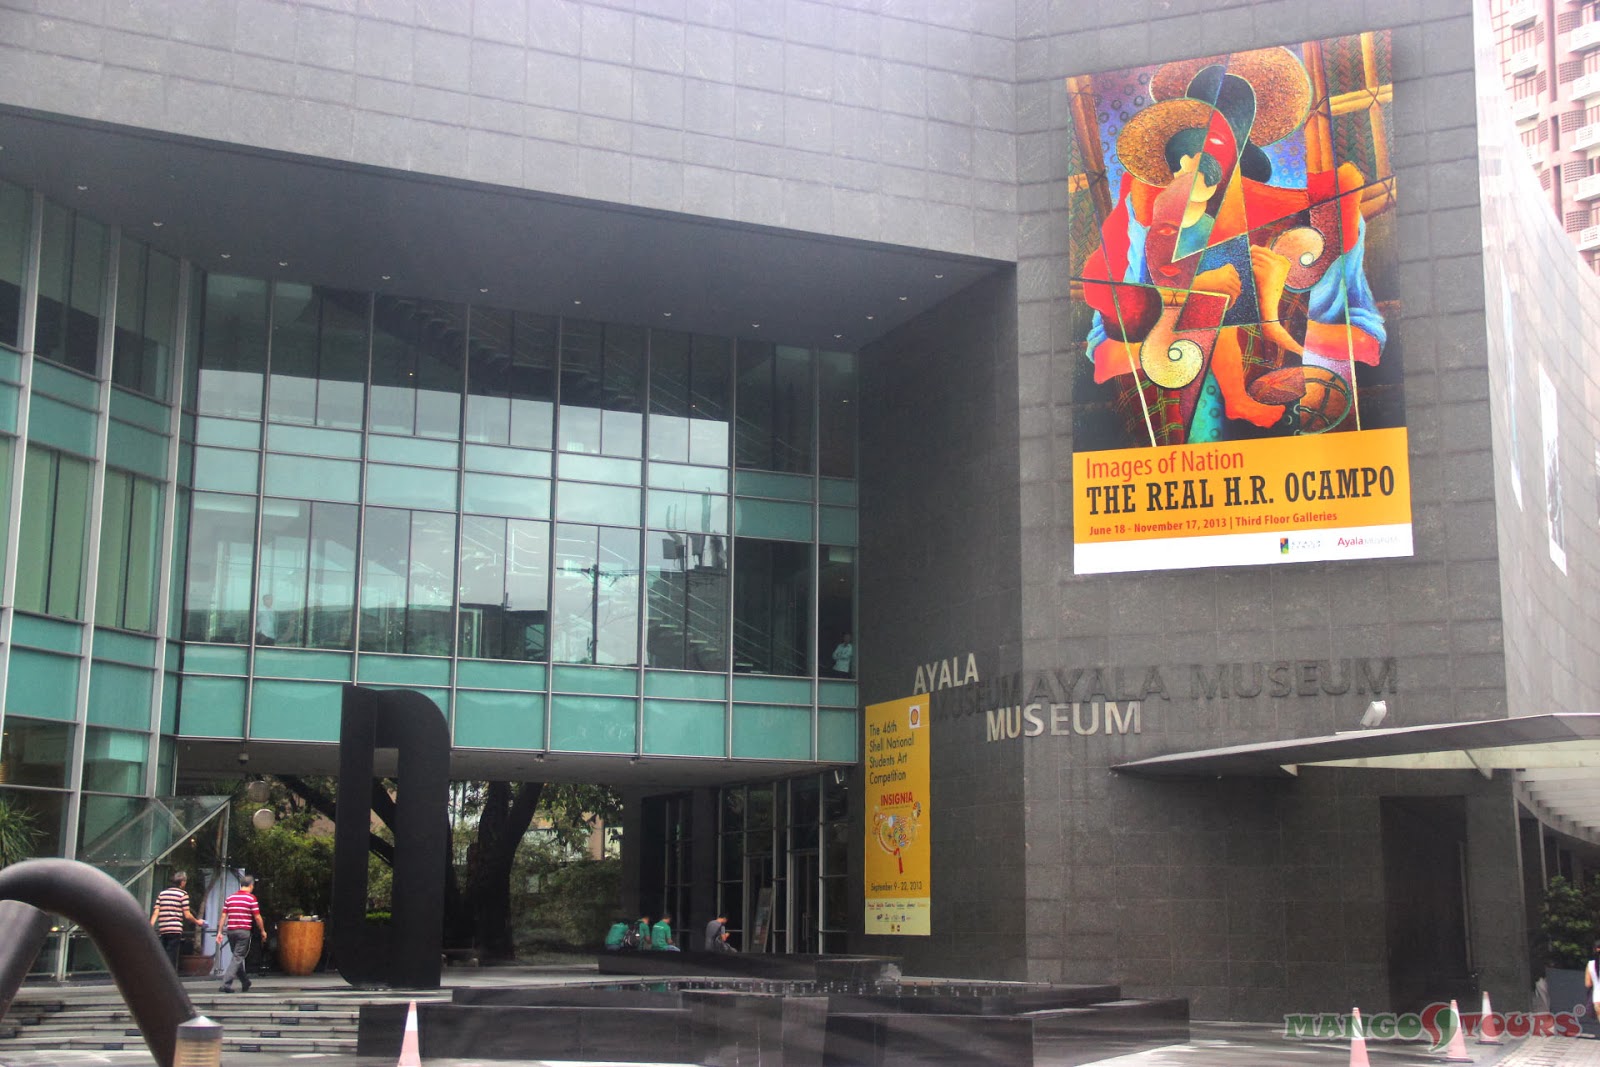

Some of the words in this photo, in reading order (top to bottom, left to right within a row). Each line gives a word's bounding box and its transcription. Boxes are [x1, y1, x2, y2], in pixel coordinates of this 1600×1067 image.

[1086, 456, 1153, 482] Images
[1158, 451, 1177, 474] of
[1182, 450, 1244, 471] Nation
[1086, 483, 1136, 515] THE
[1146, 479, 1214, 512] REAL
[1224, 476, 1274, 506] H.R.
[1284, 465, 1395, 503] OCAMPO
[1089, 525, 1112, 536] June
[1114, 524, 1126, 534] 18
[1134, 519, 1183, 532] November
[1185, 519, 1201, 530] 17,
[1203, 517, 1227, 529] 2013
[1235, 514, 1261, 527] Third
[1264, 513, 1290, 526] Floor
[1292, 511, 1338, 523] Galleries
[912, 652, 979, 696] AYALA
[1027, 665, 1170, 704] AYALA
[1191, 657, 1398, 701] MUSEUM
[869, 724, 880, 736] The
[882, 720, 897, 734] 46th
[986, 701, 1142, 743] MUSEUM
[869, 737, 884, 752] Shell
[886, 732, 915, 749] National
[869, 754, 895, 769] Students
[897, 752, 908, 764] Art
[869, 770, 907, 786] Competition
[880, 791, 913, 806] INSIGNIA
[870, 882, 893, 892] September
